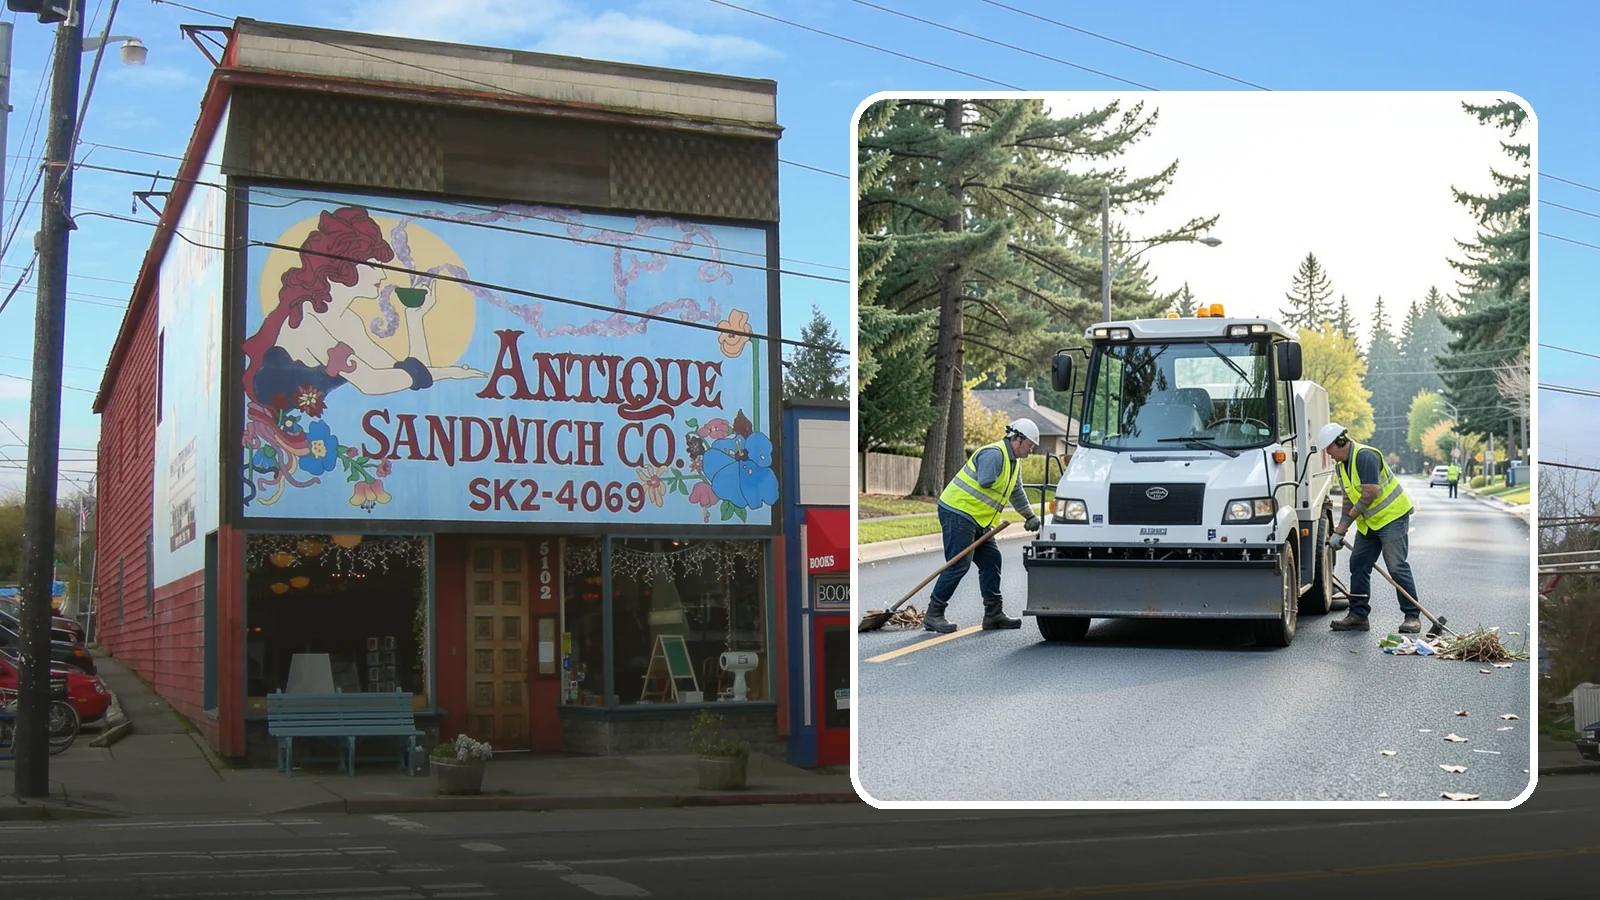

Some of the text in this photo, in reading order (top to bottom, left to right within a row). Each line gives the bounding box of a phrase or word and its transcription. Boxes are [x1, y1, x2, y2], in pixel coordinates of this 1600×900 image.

[476, 329, 724, 420] ANTIQUE
[361, 408, 685, 469] SANDWICH CO.
[468, 477, 646, 514] SK2-4069
[539, 542, 552, 600] 5102
[809, 555, 835, 569] BOOKS
